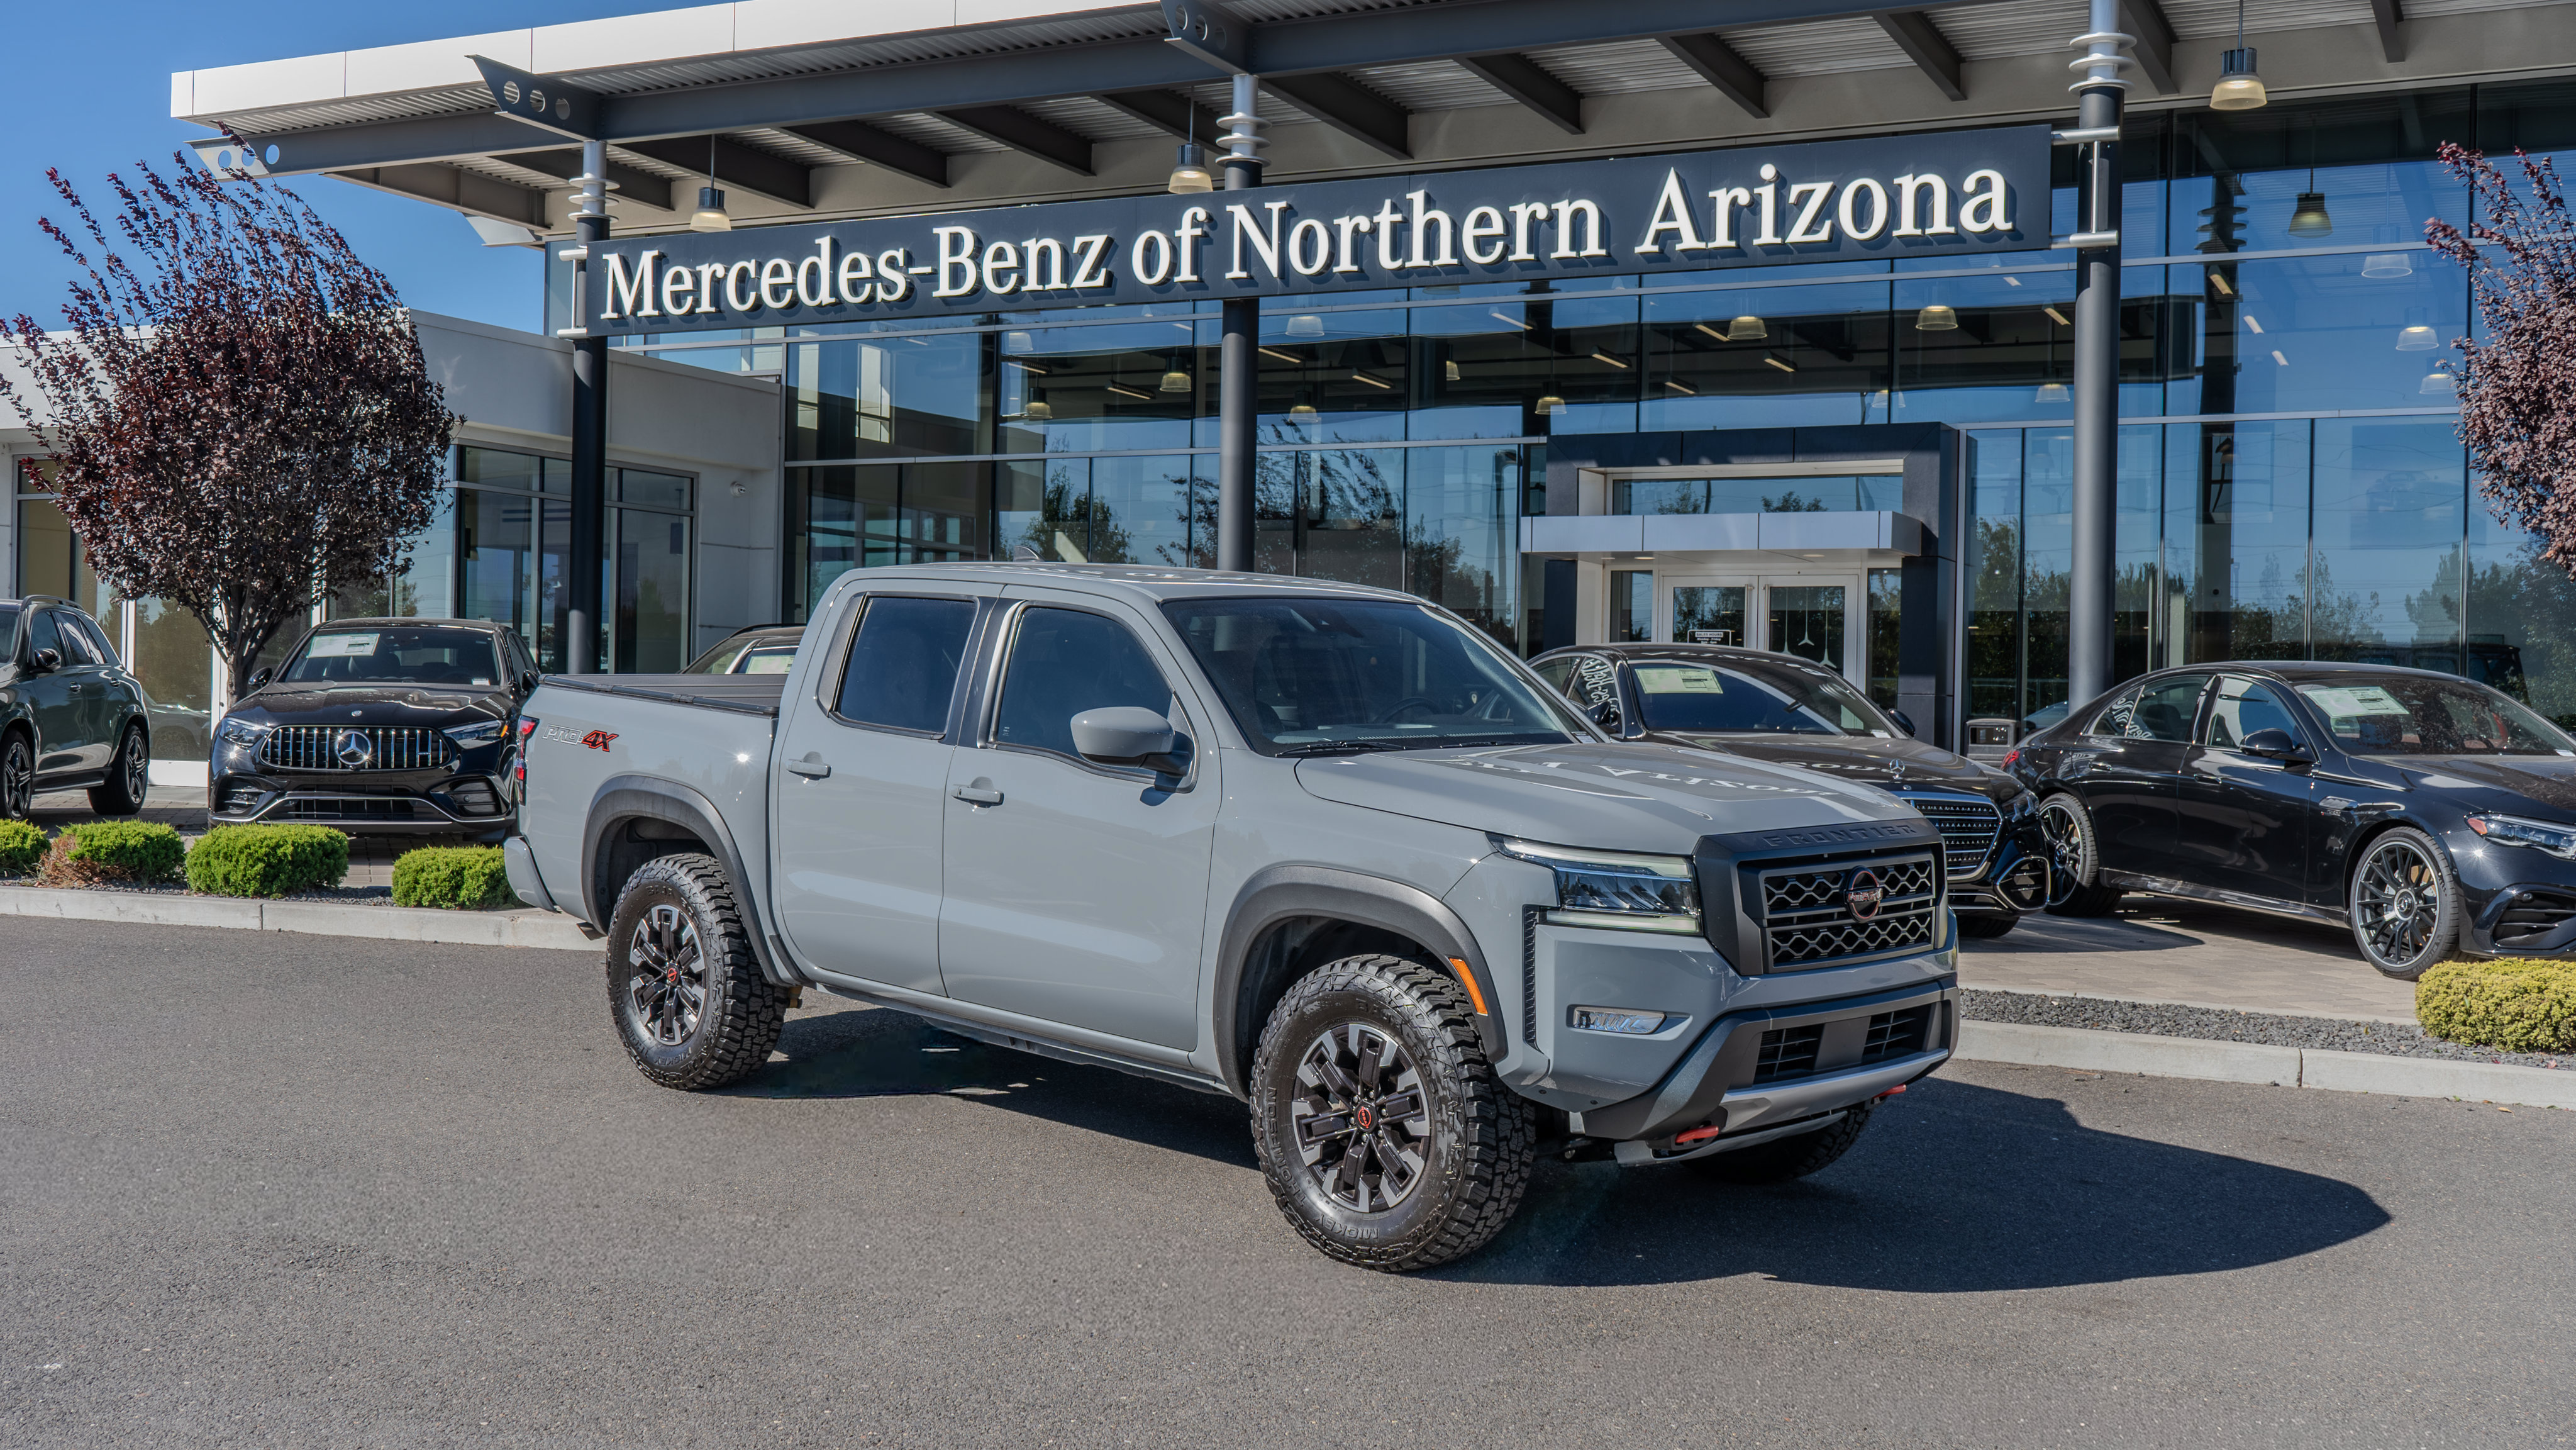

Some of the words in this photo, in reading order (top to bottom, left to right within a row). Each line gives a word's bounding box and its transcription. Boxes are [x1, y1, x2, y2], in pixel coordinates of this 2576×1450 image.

[600, 225, 1110, 320] Mercedes-Benz
[1131, 206, 1208, 285] of
[1224, 190, 1607, 279] Northern
[1634, 163, 2013, 254] Arizona
[1762, 825, 1918, 847] FRONTIER
[2412, 944, 2440, 973] MICHELIN
[655, 1047, 691, 1066] MICKEY
[1267, 1086, 1306, 1207] THOMPSON
[1316, 1214, 1379, 1239] MICKEY
